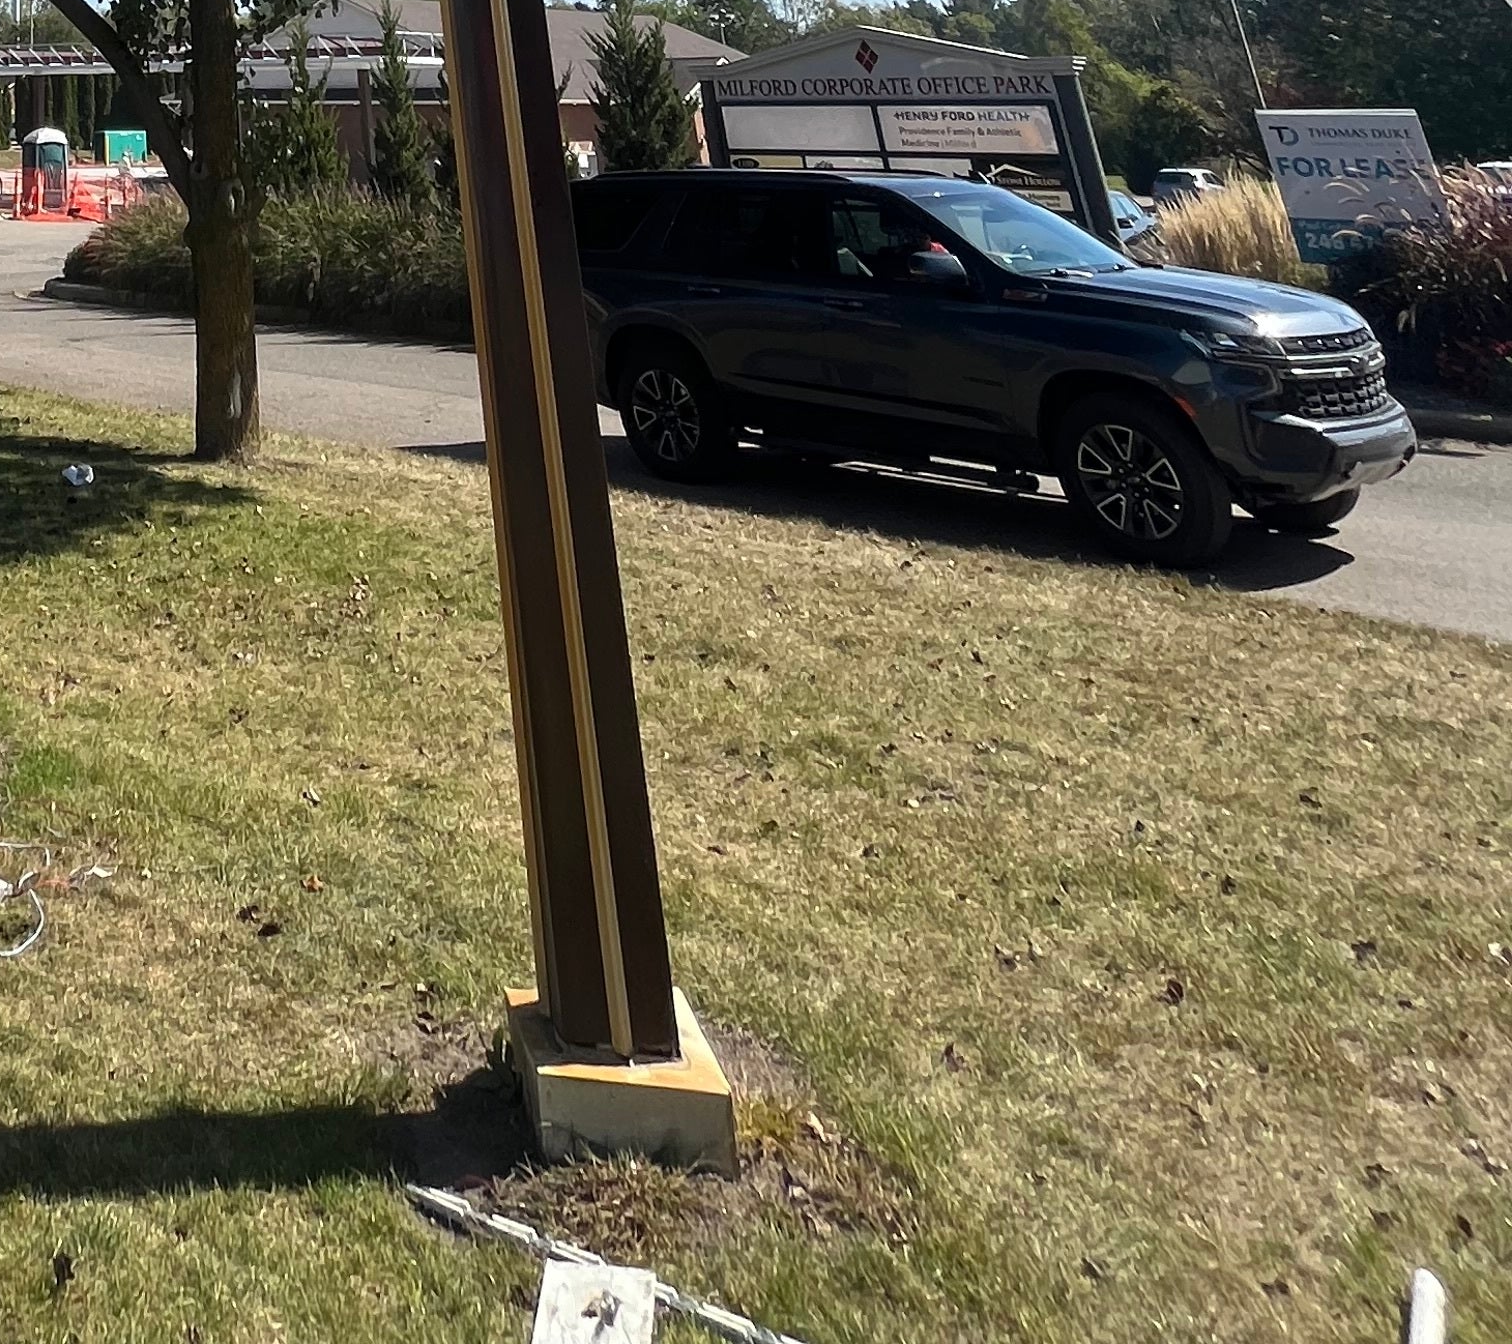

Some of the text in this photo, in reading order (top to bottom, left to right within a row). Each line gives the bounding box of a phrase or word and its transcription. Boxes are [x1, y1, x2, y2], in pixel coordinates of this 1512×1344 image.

[717, 75, 1052, 97] MILFORD CORPORATE OFFICE PARK
[893, 111, 1030, 122] HENRY FORD HEALTH
[1308, 127, 1414, 140] THOMAS DUKE
[1274, 156, 1431, 180] FOR LEASE
